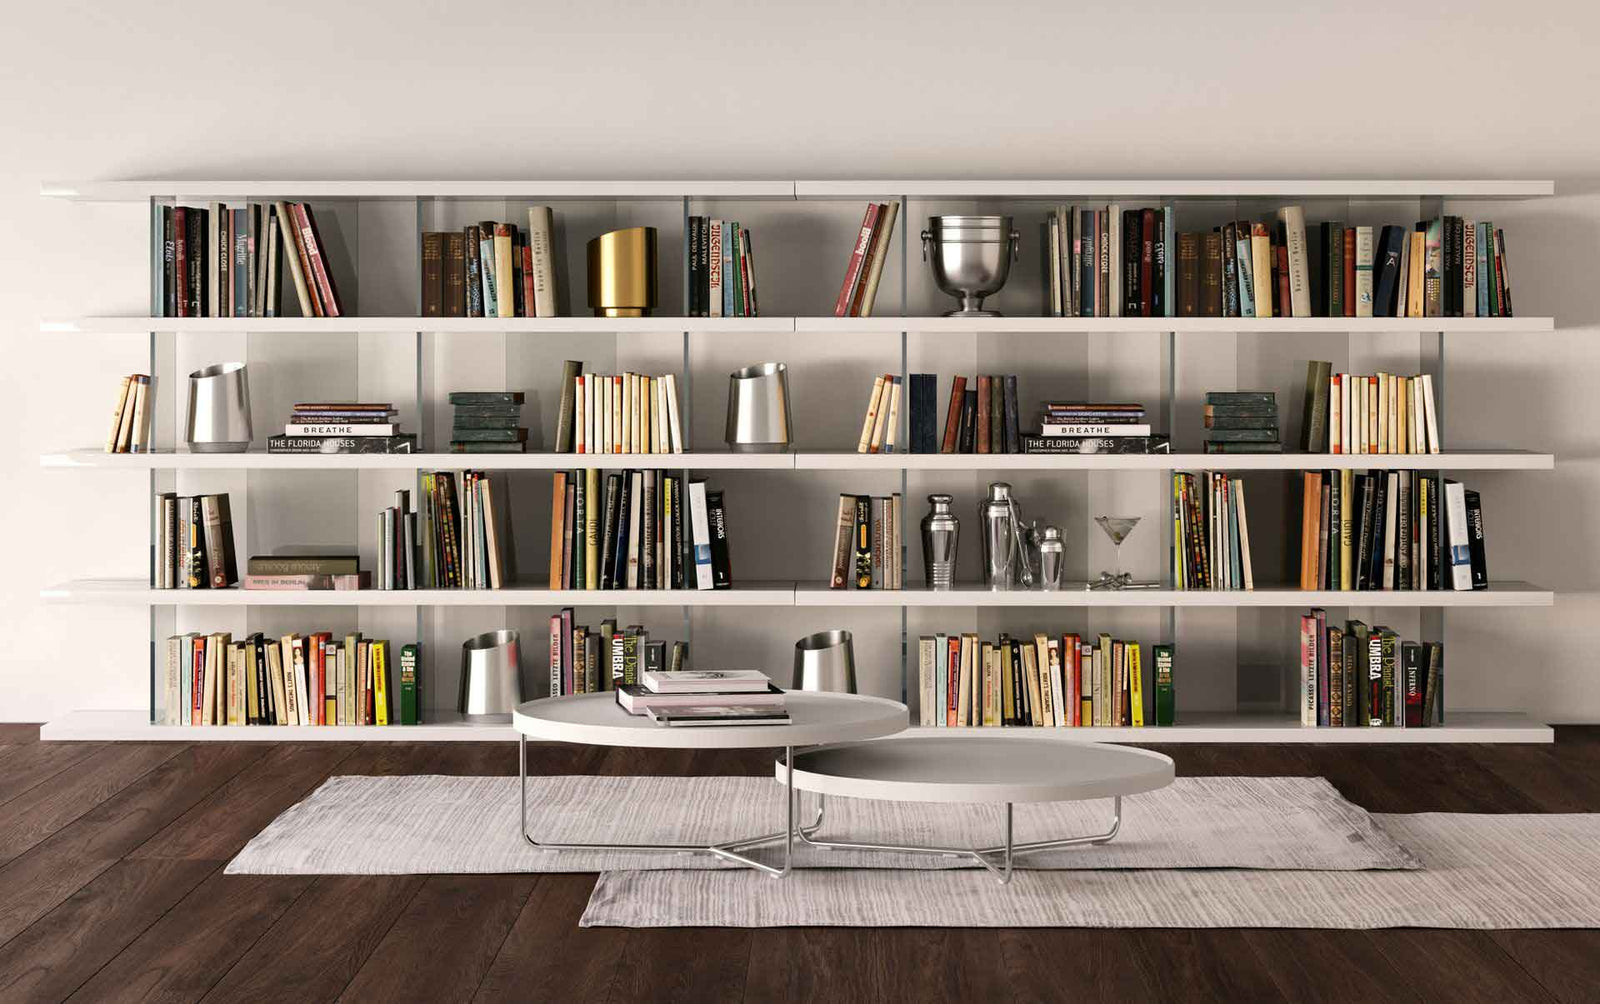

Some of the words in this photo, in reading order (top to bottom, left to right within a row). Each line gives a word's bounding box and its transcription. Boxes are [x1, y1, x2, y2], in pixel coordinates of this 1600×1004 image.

[165, 240, 175, 263] Elvis
[219, 230, 227, 252] CHUCK
[234, 233, 247, 266] Magritte
[301, 226, 318, 256] Blood
[219, 252, 227, 272] CLOSE
[710, 224, 720, 289] JUGENDSTIL
[1464, 224, 1475, 289] JUGENDSTIL
[270, 439, 286, 448] THE
[288, 439, 321, 448] FLORIDA
[303, 426, 352, 434] BREATHE
[1028, 439, 1045, 448] THE
[1047, 439, 1080, 448] FLORIDA
[1061, 426, 1111, 434] BREATHE
[714, 508, 725, 540] INTERIORS
[1331, 487, 1339, 535] HORTA
[1472, 508, 1483, 540] INTERIORS
[589, 519, 599, 546] GAUDI
[1343, 519, 1353, 547] GAUDI
[623, 636, 636, 653] The
[1382, 636, 1396, 654] The
[612, 639, 624, 679] UMBRA
[623, 656, 637, 684] Pianis
[1369, 639, 1381, 681] UMBRA
[1382, 657, 1397, 687] Pianist
[1408, 667, 1417, 696] INFERNO
